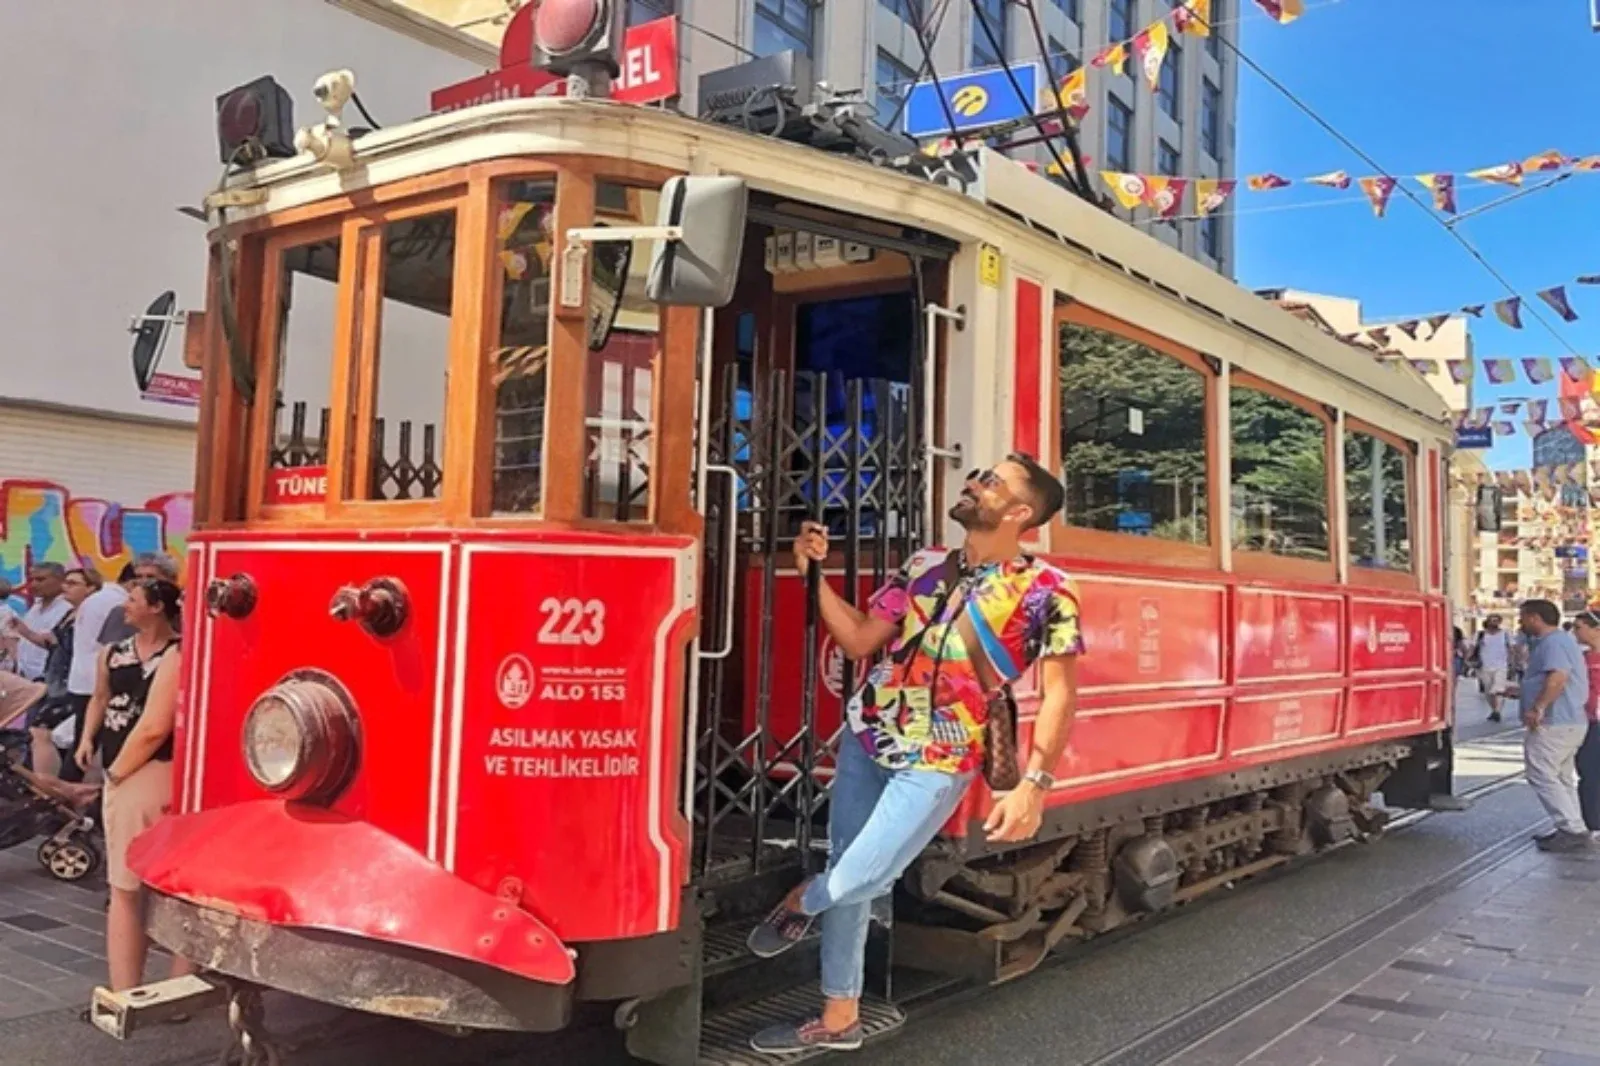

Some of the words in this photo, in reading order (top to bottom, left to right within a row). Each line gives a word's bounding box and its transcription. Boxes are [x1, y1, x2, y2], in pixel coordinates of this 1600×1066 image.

[537, 597, 605, 645] 223
[540, 685, 585, 700] ALO
[590, 685, 626, 700] 153
[490, 728, 575, 748] ASILMAK
[580, 729, 637, 748] YASAK
[484, 756, 507, 775] VE
[511, 754, 639, 777] TEHLİKELİDİR
